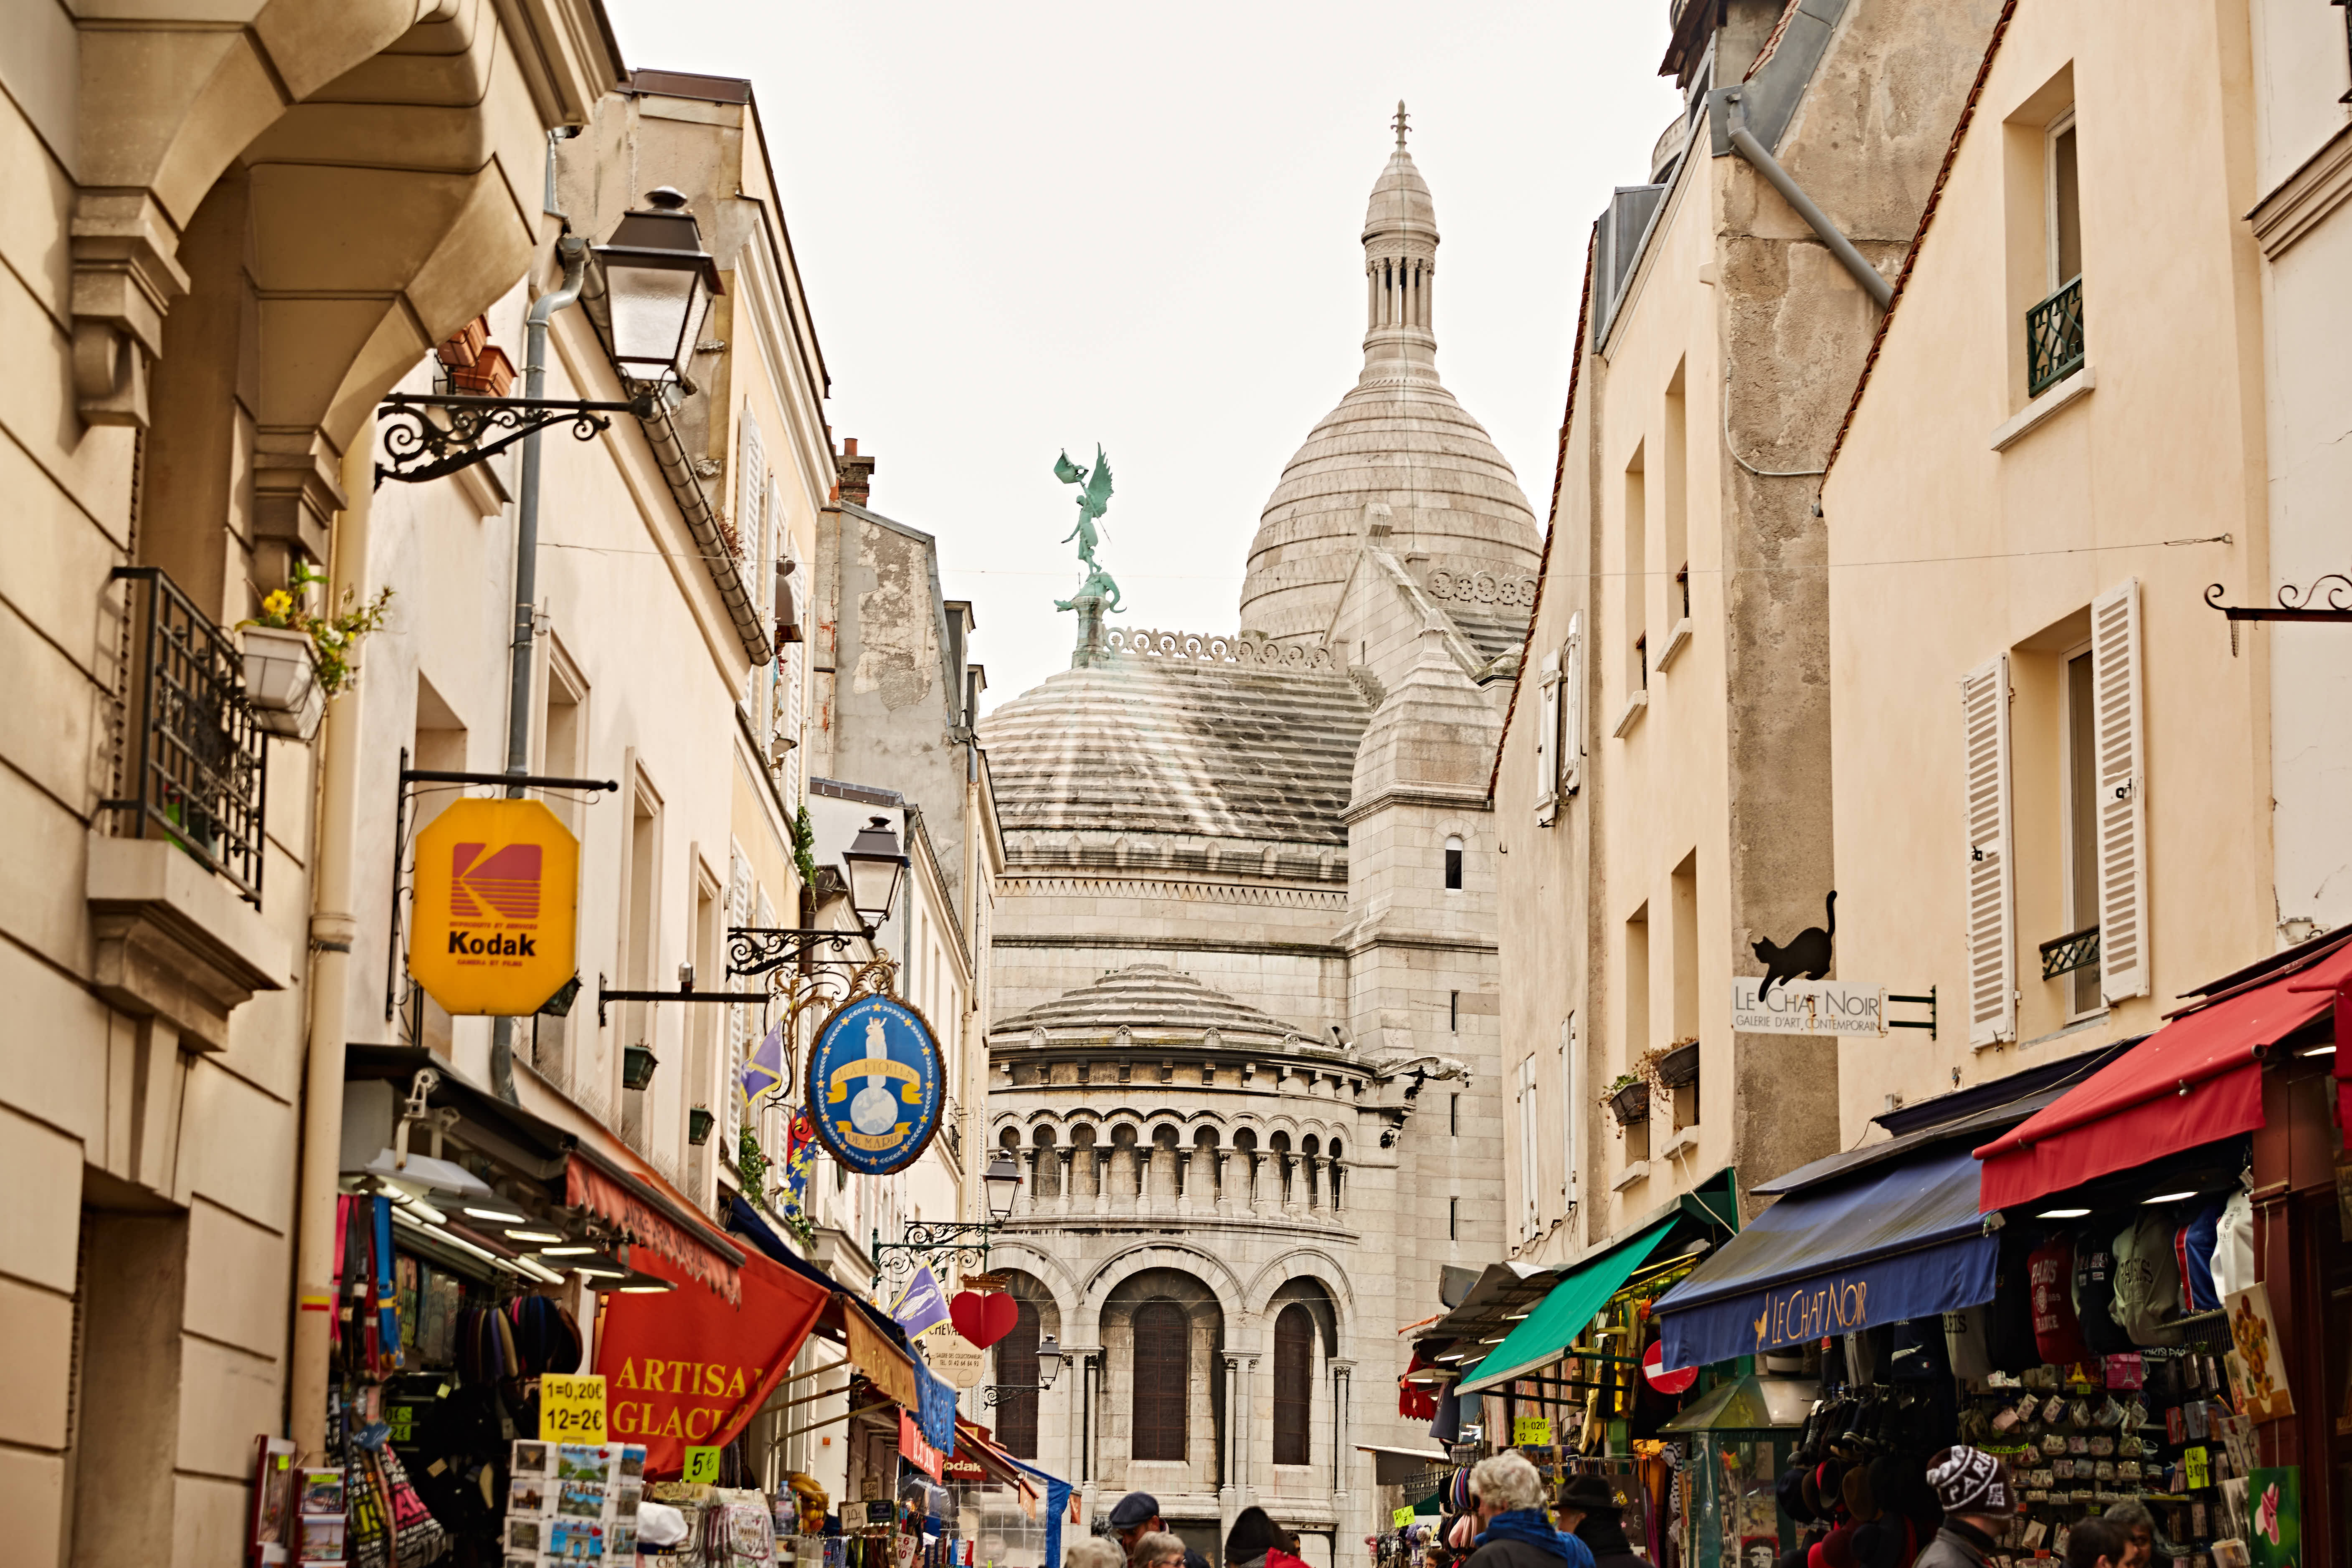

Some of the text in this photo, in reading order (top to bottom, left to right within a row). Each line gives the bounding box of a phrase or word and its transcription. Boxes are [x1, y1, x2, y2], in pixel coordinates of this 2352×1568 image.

[449, 931, 537, 956] Kodak
[1736, 986, 1879, 1016] LE CHAT NOIR
[1736, 1015, 1879, 1031] GALERIE D'ART CONTEMPORAIN
[836, 1063, 858, 1082] AUX
[848, 1133, 900, 1148] DE MARIE
[1772, 1279, 1867, 1344] LE CHAT NOIR
[547, 1381, 602, 1402] 1=0,20€
[547, 1408, 602, 1431] 12=2€
[942, 1459, 983, 1472] odak
[1949, 1451, 1991, 1502] PARIS
